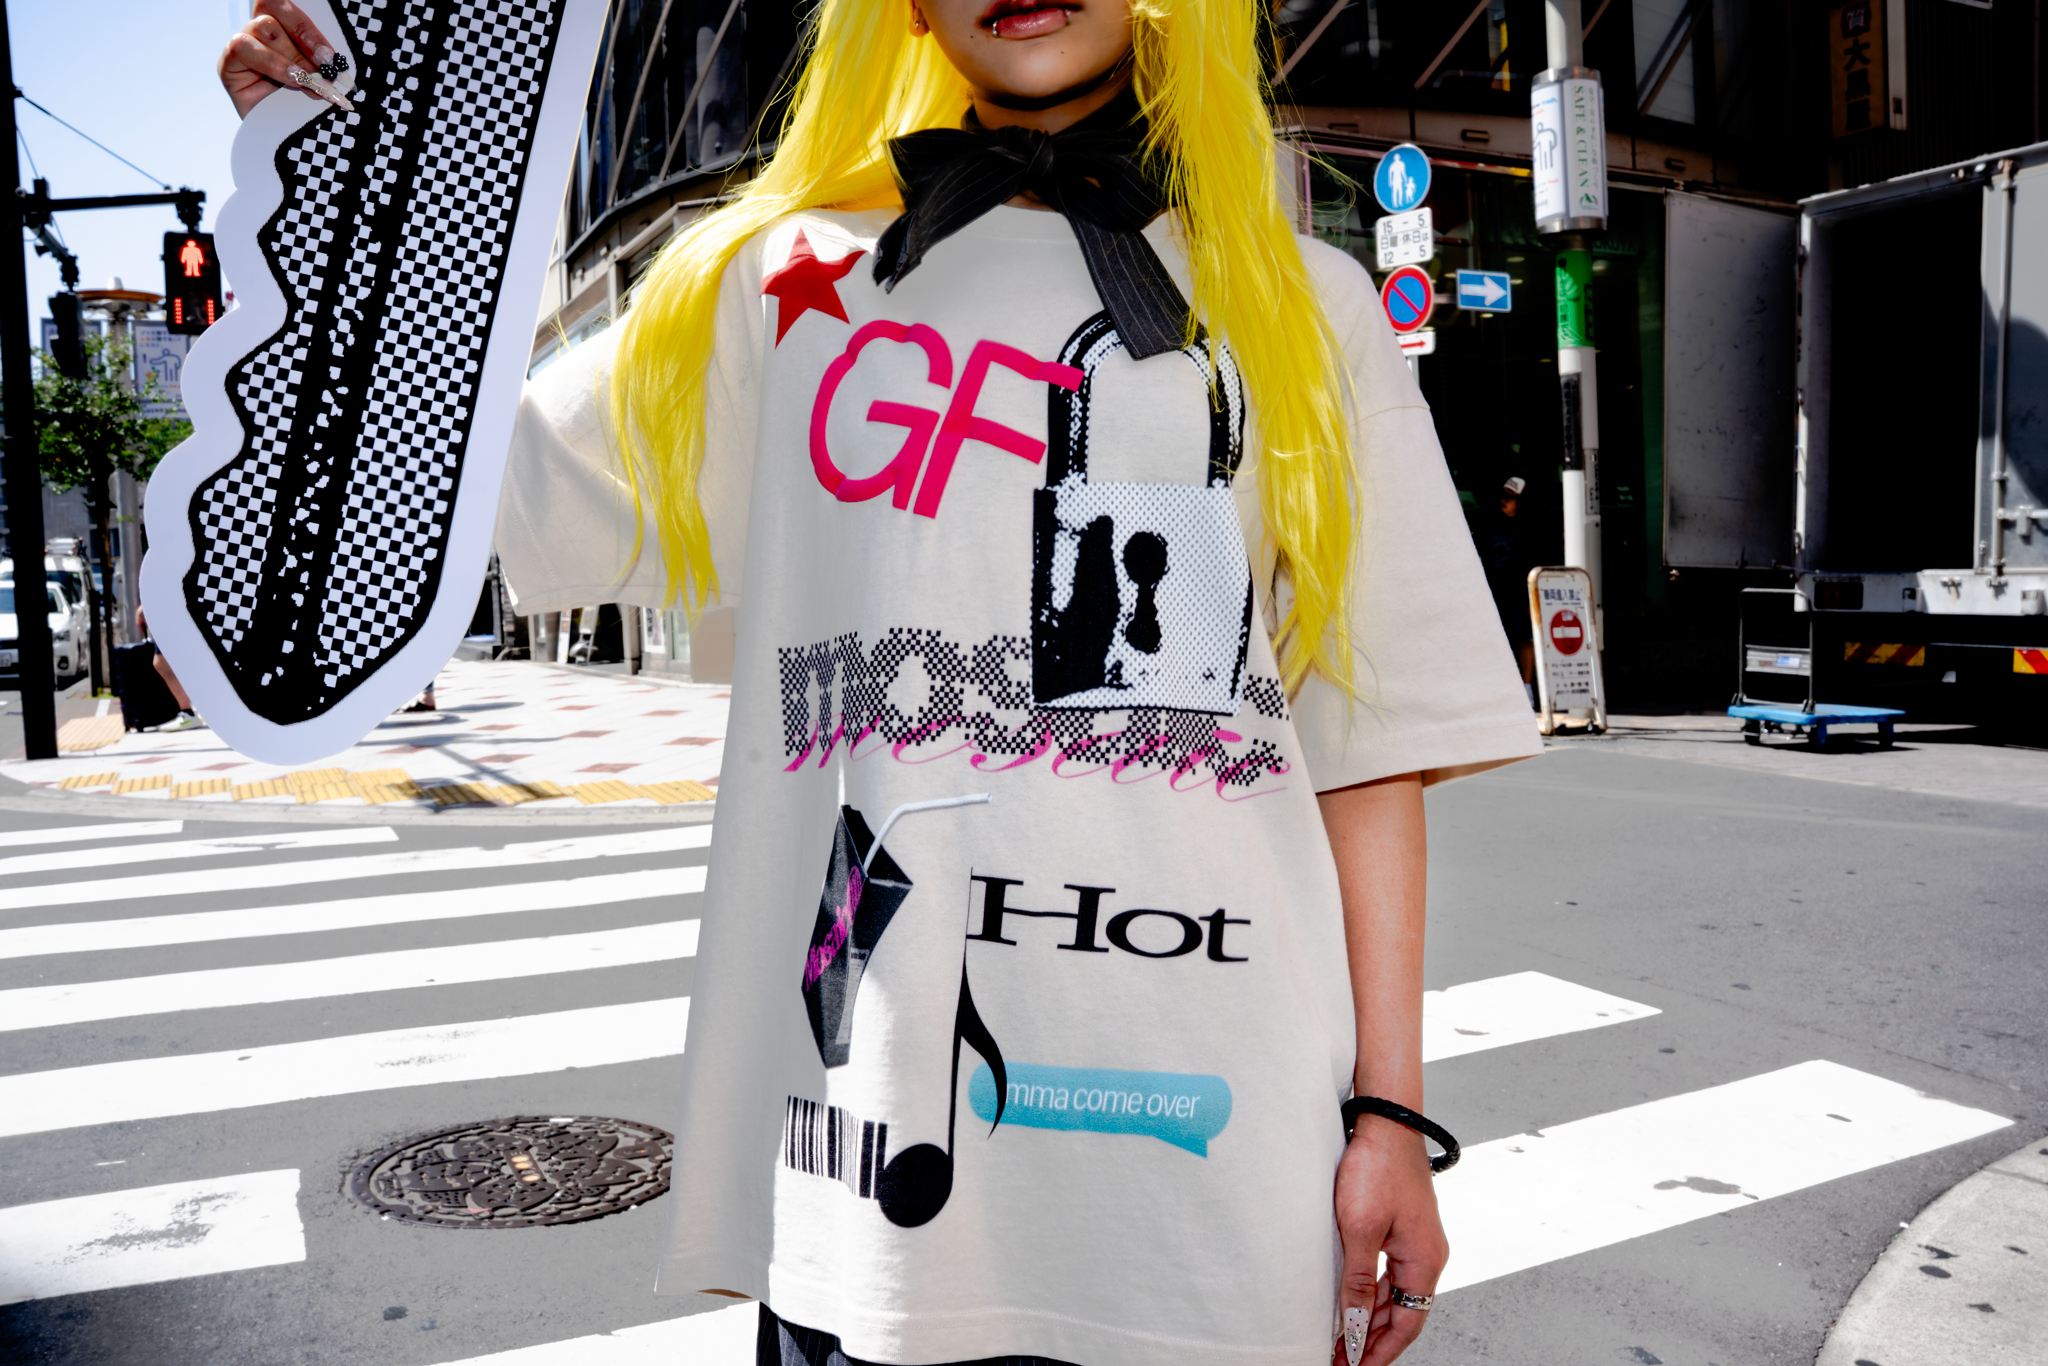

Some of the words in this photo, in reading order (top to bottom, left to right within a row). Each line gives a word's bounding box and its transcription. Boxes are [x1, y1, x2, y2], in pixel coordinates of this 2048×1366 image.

[1573, 86, 1586, 122] SAFE
[1576, 139, 1589, 188] CLEAN
[1382, 221, 1393, 234] 15
[1418, 213, 1425, 227] 5
[1384, 251, 1394, 265] 12
[1419, 244, 1426, 258] 5
[809, 320, 1085, 519] GF
[966, 874, 1251, 963] Hot
[1073, 1088, 1142, 1114] come
[1147, 1094, 1200, 1118] over
